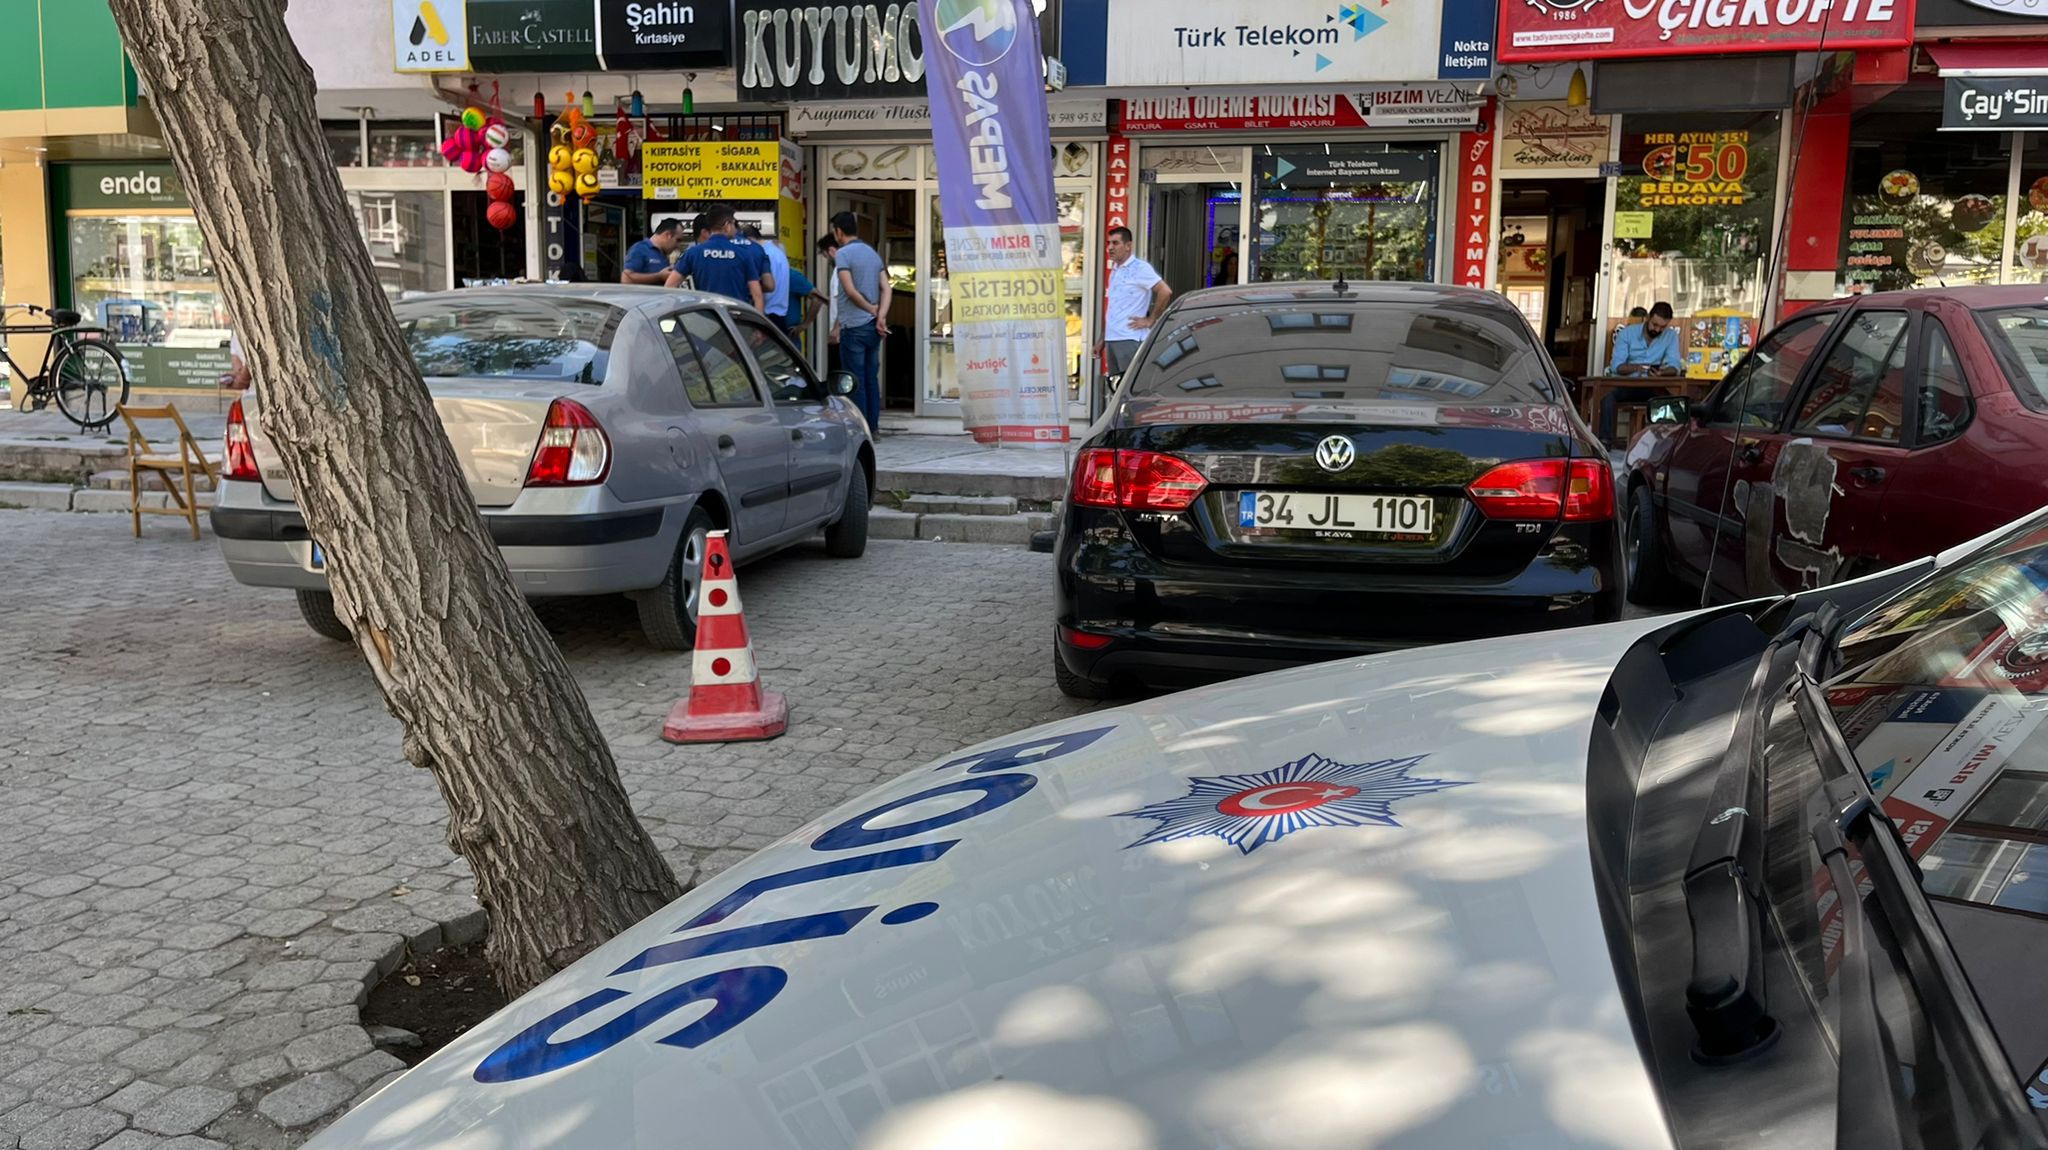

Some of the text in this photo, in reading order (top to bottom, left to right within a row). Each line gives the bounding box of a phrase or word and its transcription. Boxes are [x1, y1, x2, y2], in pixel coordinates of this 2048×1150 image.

[626, 2, 695, 32] Şahin
[1553, 11, 1577, 20] 1986
[472, 23, 592, 45] FABER-CASTELL
[635, 32, 686, 45] Kırtasiye
[1174, 24, 1339, 48] Türk Telekom
[1454, 40, 1490, 53] Nokta
[407, 51, 456, 62] ADEL
[1445, 54, 1488, 70] İletişim
[1126, 98, 1190, 120] FATURA
[1258, 94, 1336, 118] NOKTASI
[798, 105, 877, 126] Kuyumcu
[1408, 116, 1471, 125] NOKTA İLETİŞİM
[1208, 121, 1219, 129] TL
[1290, 120, 1336, 128] BAŞVURU
[1644, 133, 1675, 144] HER
[1678, 132, 1717, 143] AYIN
[650, 145, 760, 156] KIRTASİYE SİGARA
[650, 160, 778, 172] FOTOKOPİ BAKKALİYE
[1338, 168, 1369, 176] Başvuru
[100, 170, 161, 194] enda
[650, 175, 772, 188] RENKLİ ÇIKTI OYUNCAK
[1108, 144, 1126, 227] FATURA
[703, 189, 723, 198] FAX
[1640, 182, 1743, 194] BEDAVA
[1240, 511, 1254, 520] TR
[1256, 494, 1431, 530] 34 JL 1101
[1515, 523, 1542, 533] TDI
[1315, 531, 1353, 539] S.KAYA
